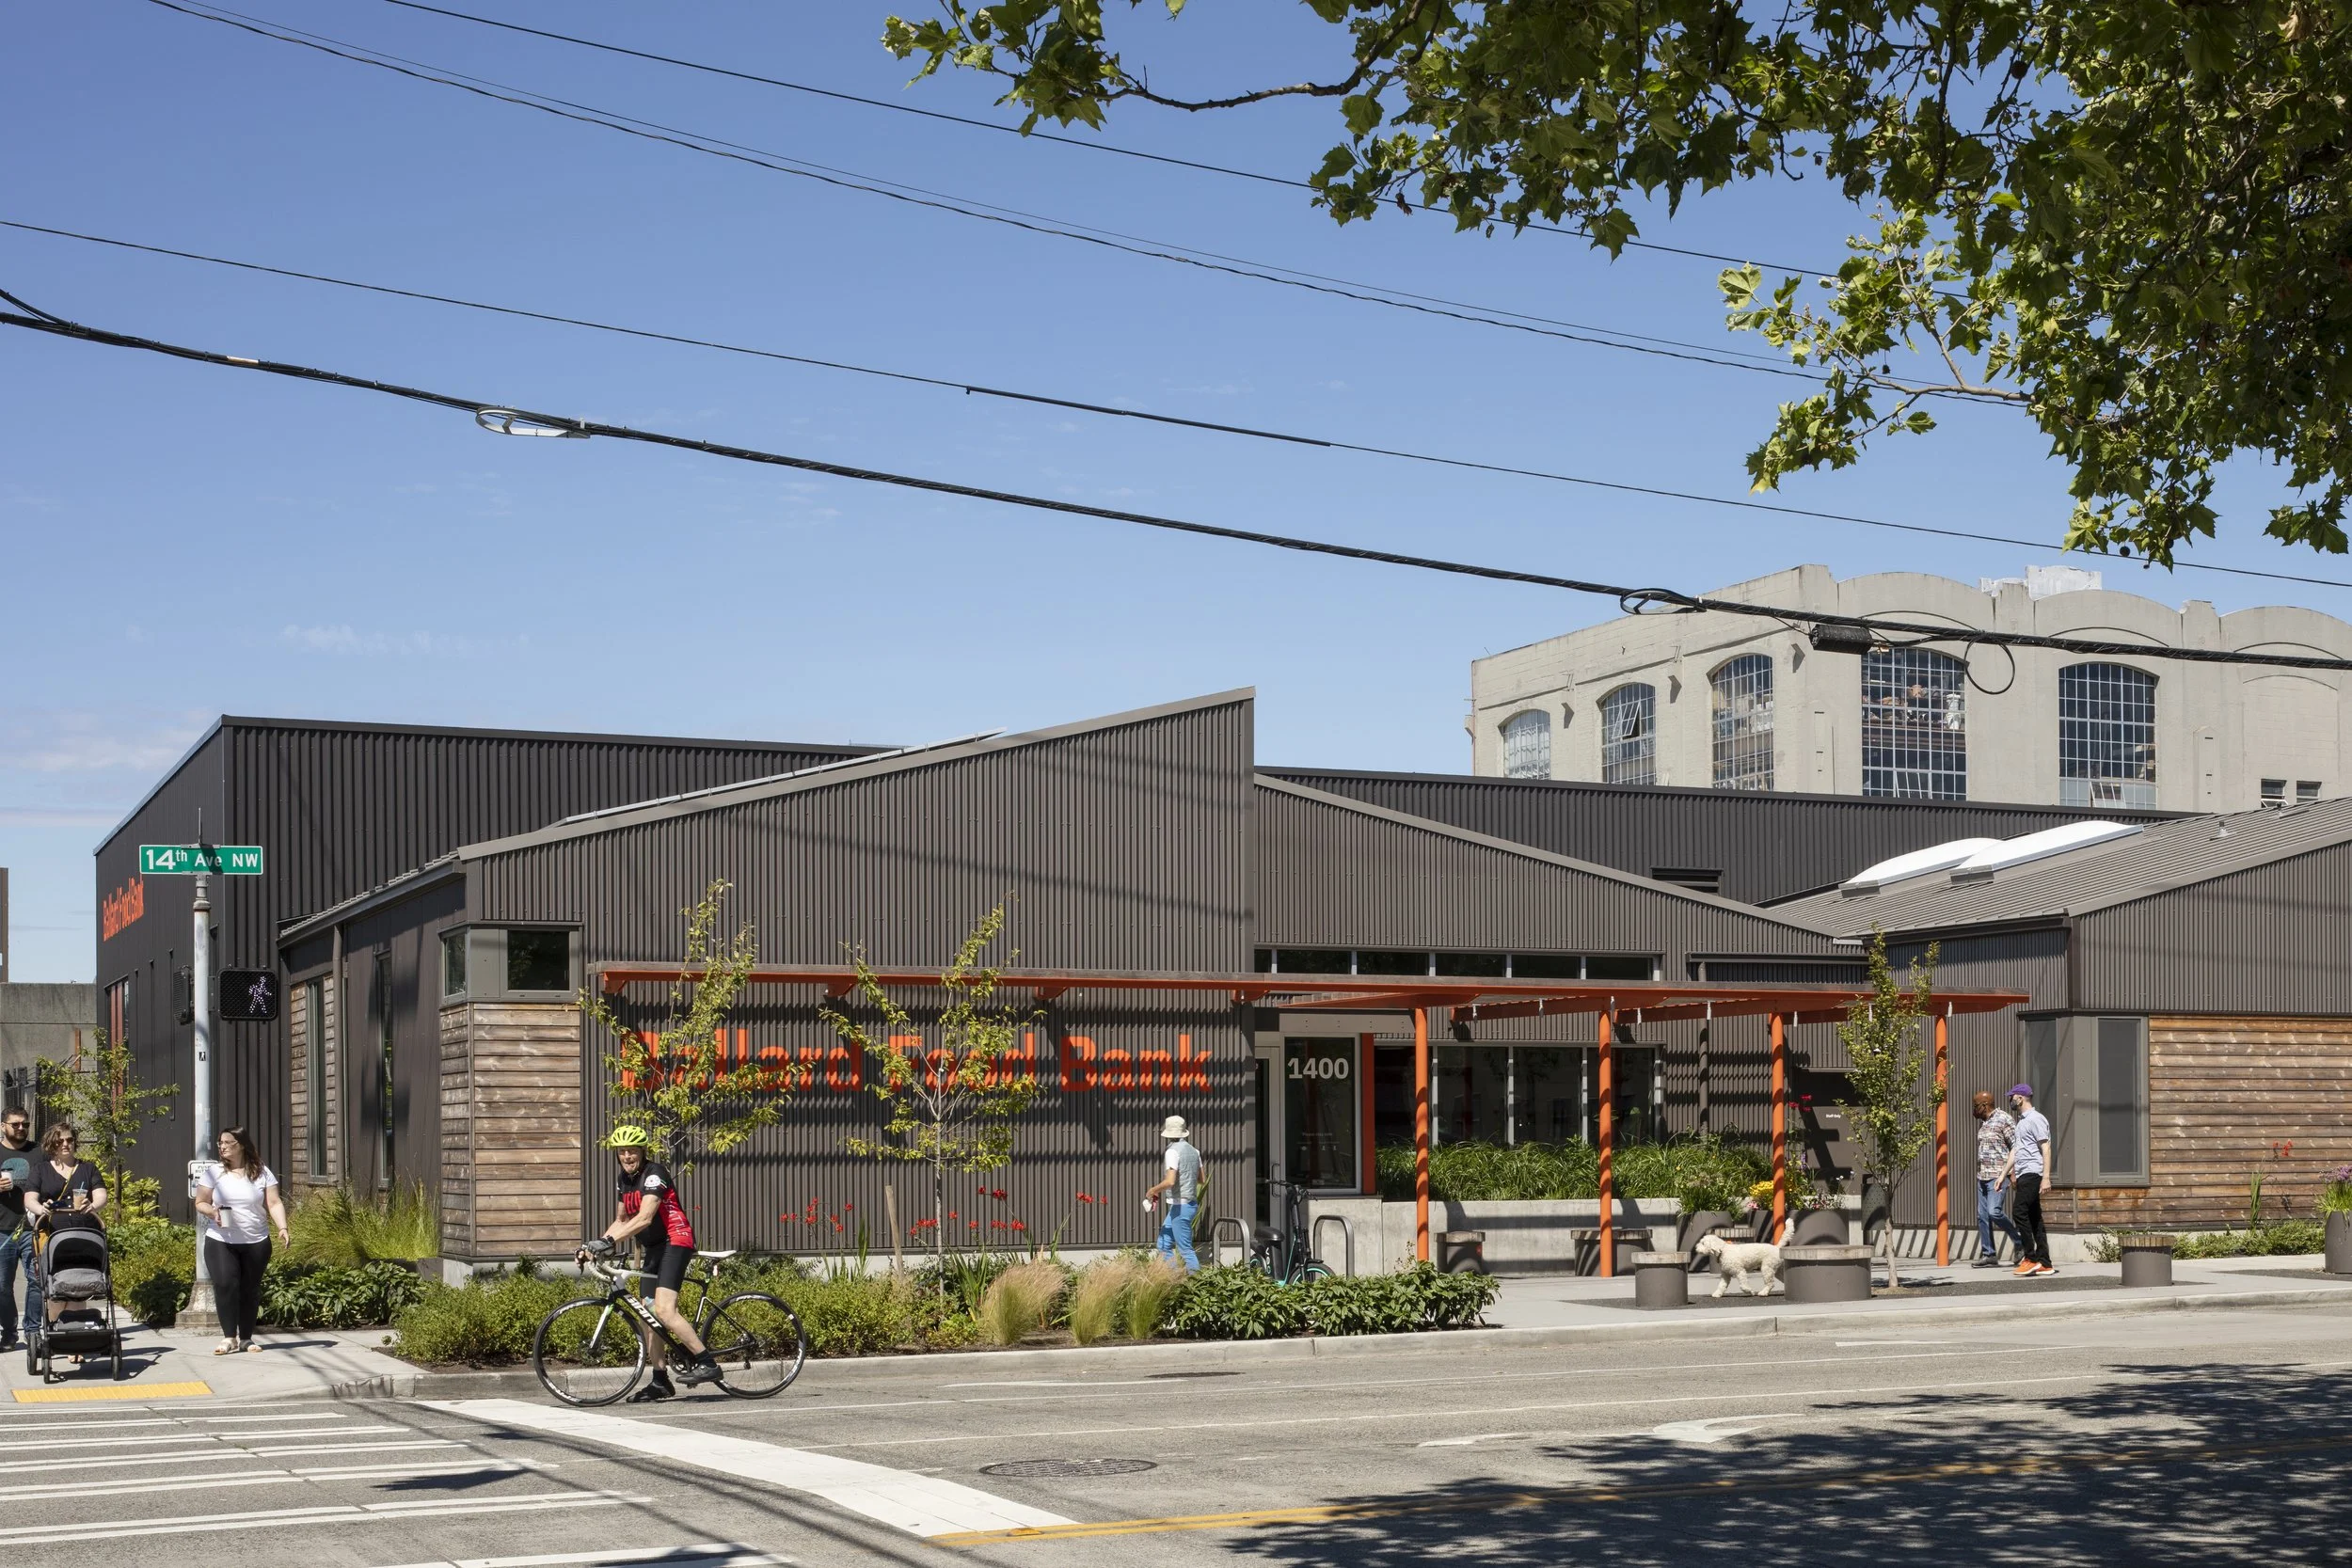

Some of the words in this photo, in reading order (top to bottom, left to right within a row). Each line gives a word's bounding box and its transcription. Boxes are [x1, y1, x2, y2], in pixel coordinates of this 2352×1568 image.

[146, 849, 188, 870] 14th
[194, 852, 222, 867] Ave
[232, 853, 259, 867] NW
[1061, 1034, 1214, 1092] Bank
[1287, 1057, 1349, 1080] 1400
[626, 1296, 662, 1328] GIANT
